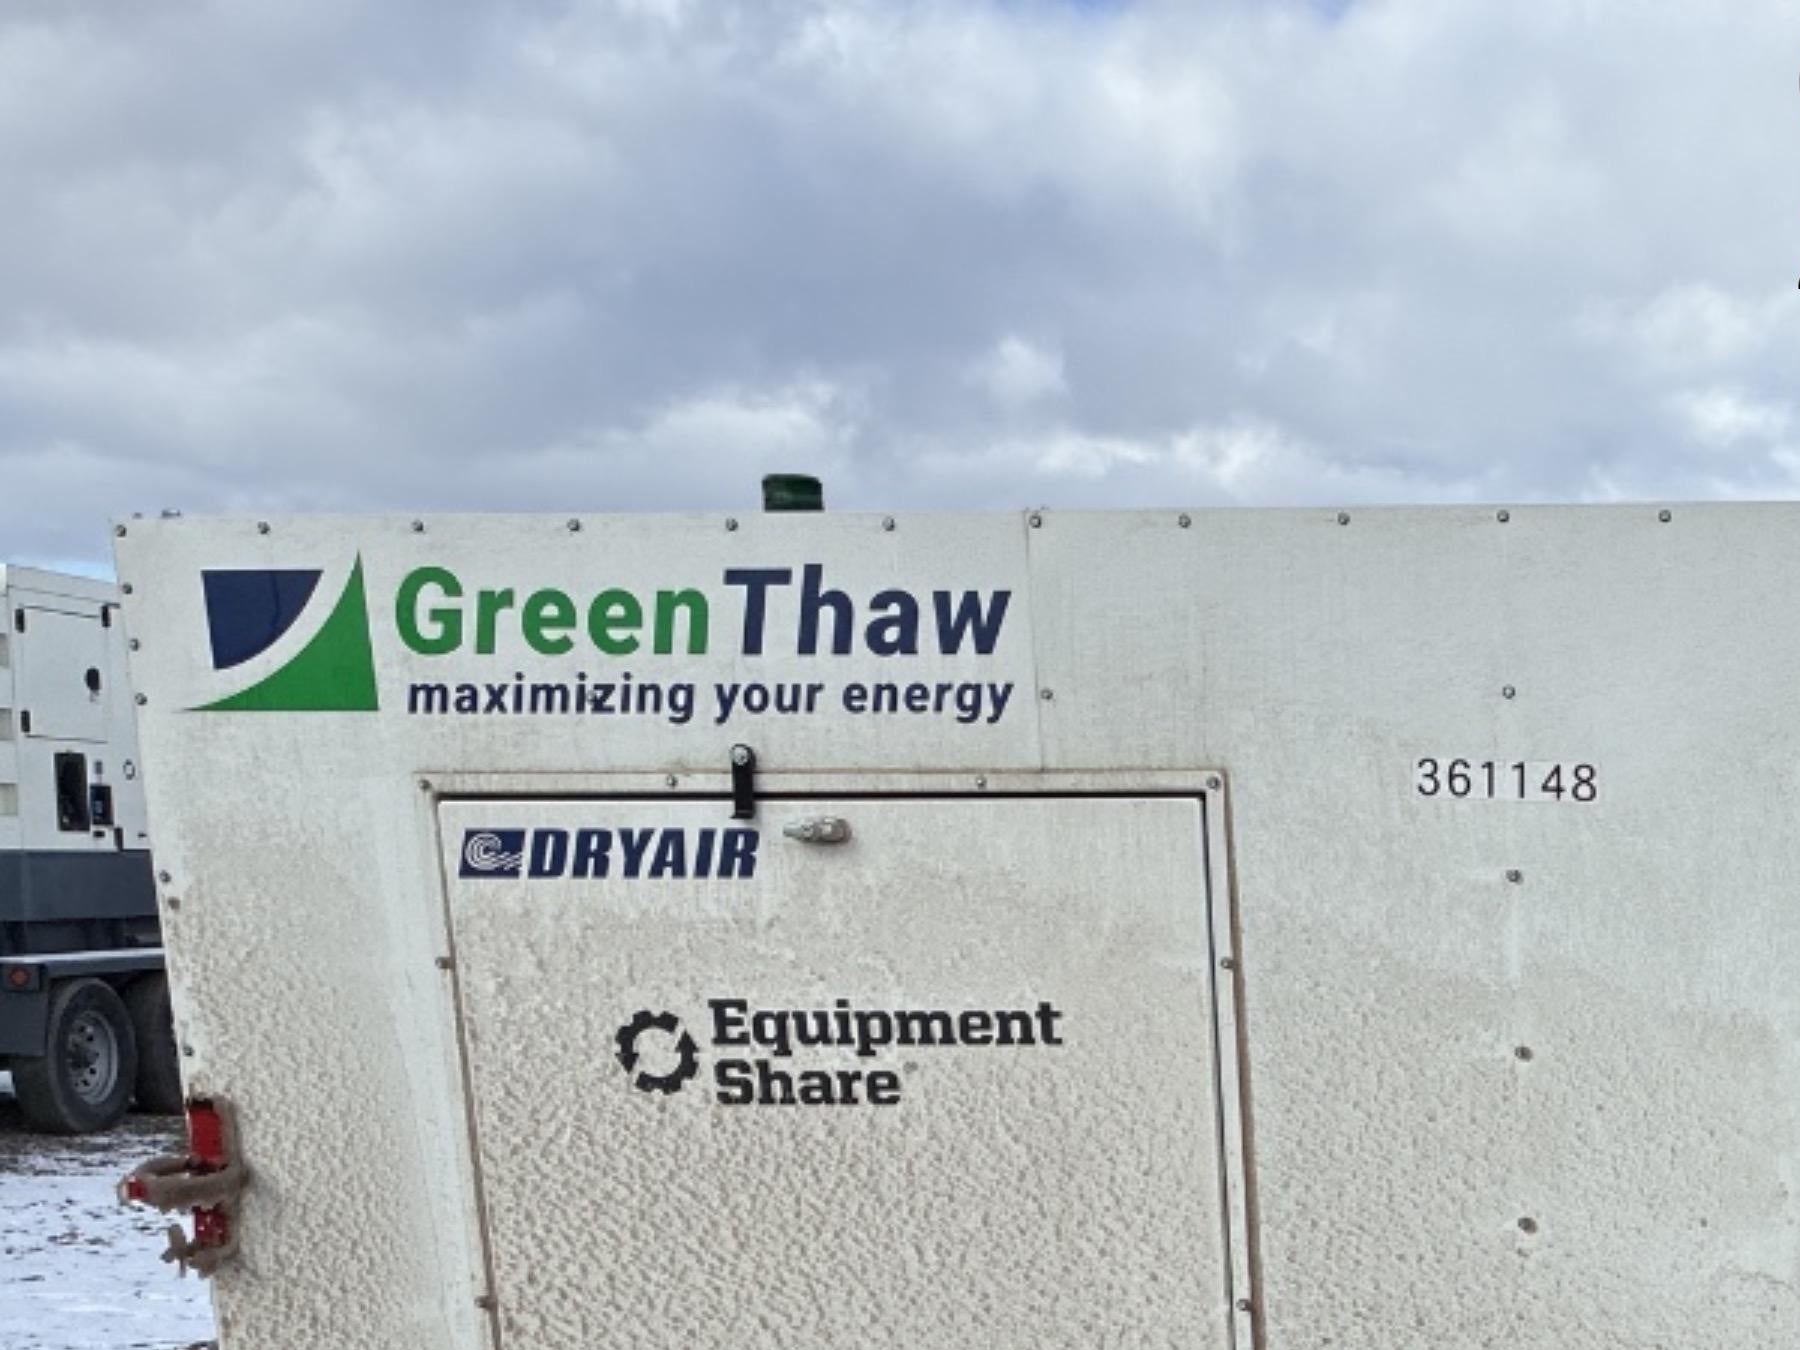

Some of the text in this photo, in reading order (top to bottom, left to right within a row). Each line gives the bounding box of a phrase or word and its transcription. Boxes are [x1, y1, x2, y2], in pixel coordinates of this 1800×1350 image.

[395, 564, 1013, 656] GreenThaw
[407, 671, 1013, 725] maximizing your energy
[1417, 758, 1598, 802] 361148
[524, 826, 760, 880] DRYAIR
[708, 999, 1063, 1057] Equipment
[715, 1059, 901, 1106] Share
